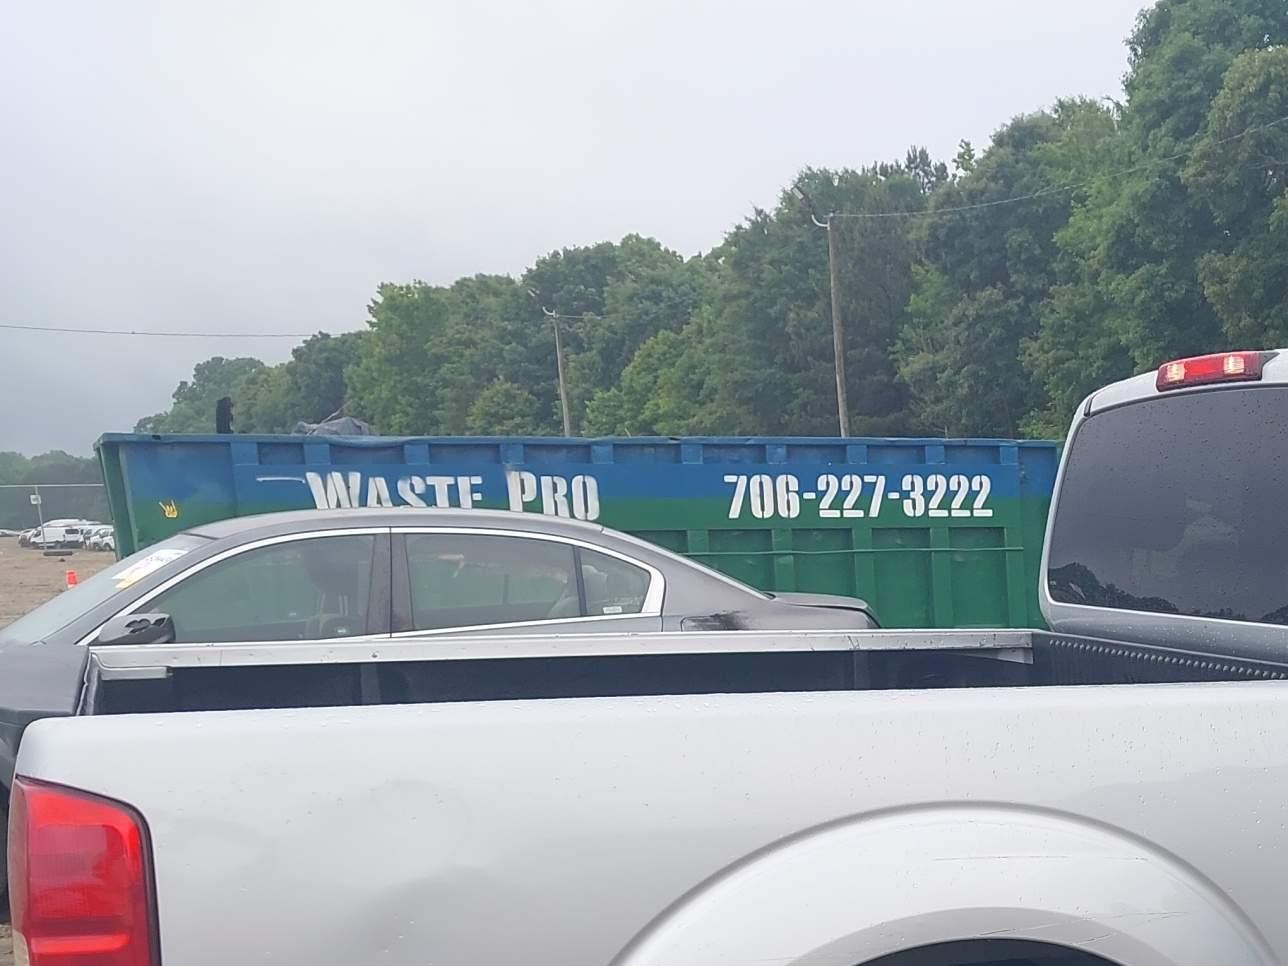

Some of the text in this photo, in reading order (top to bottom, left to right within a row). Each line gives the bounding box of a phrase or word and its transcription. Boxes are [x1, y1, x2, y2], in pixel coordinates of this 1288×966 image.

[305, 470, 601, 521] WASTE PRO
[723, 474, 993, 519] 706-227-3222
